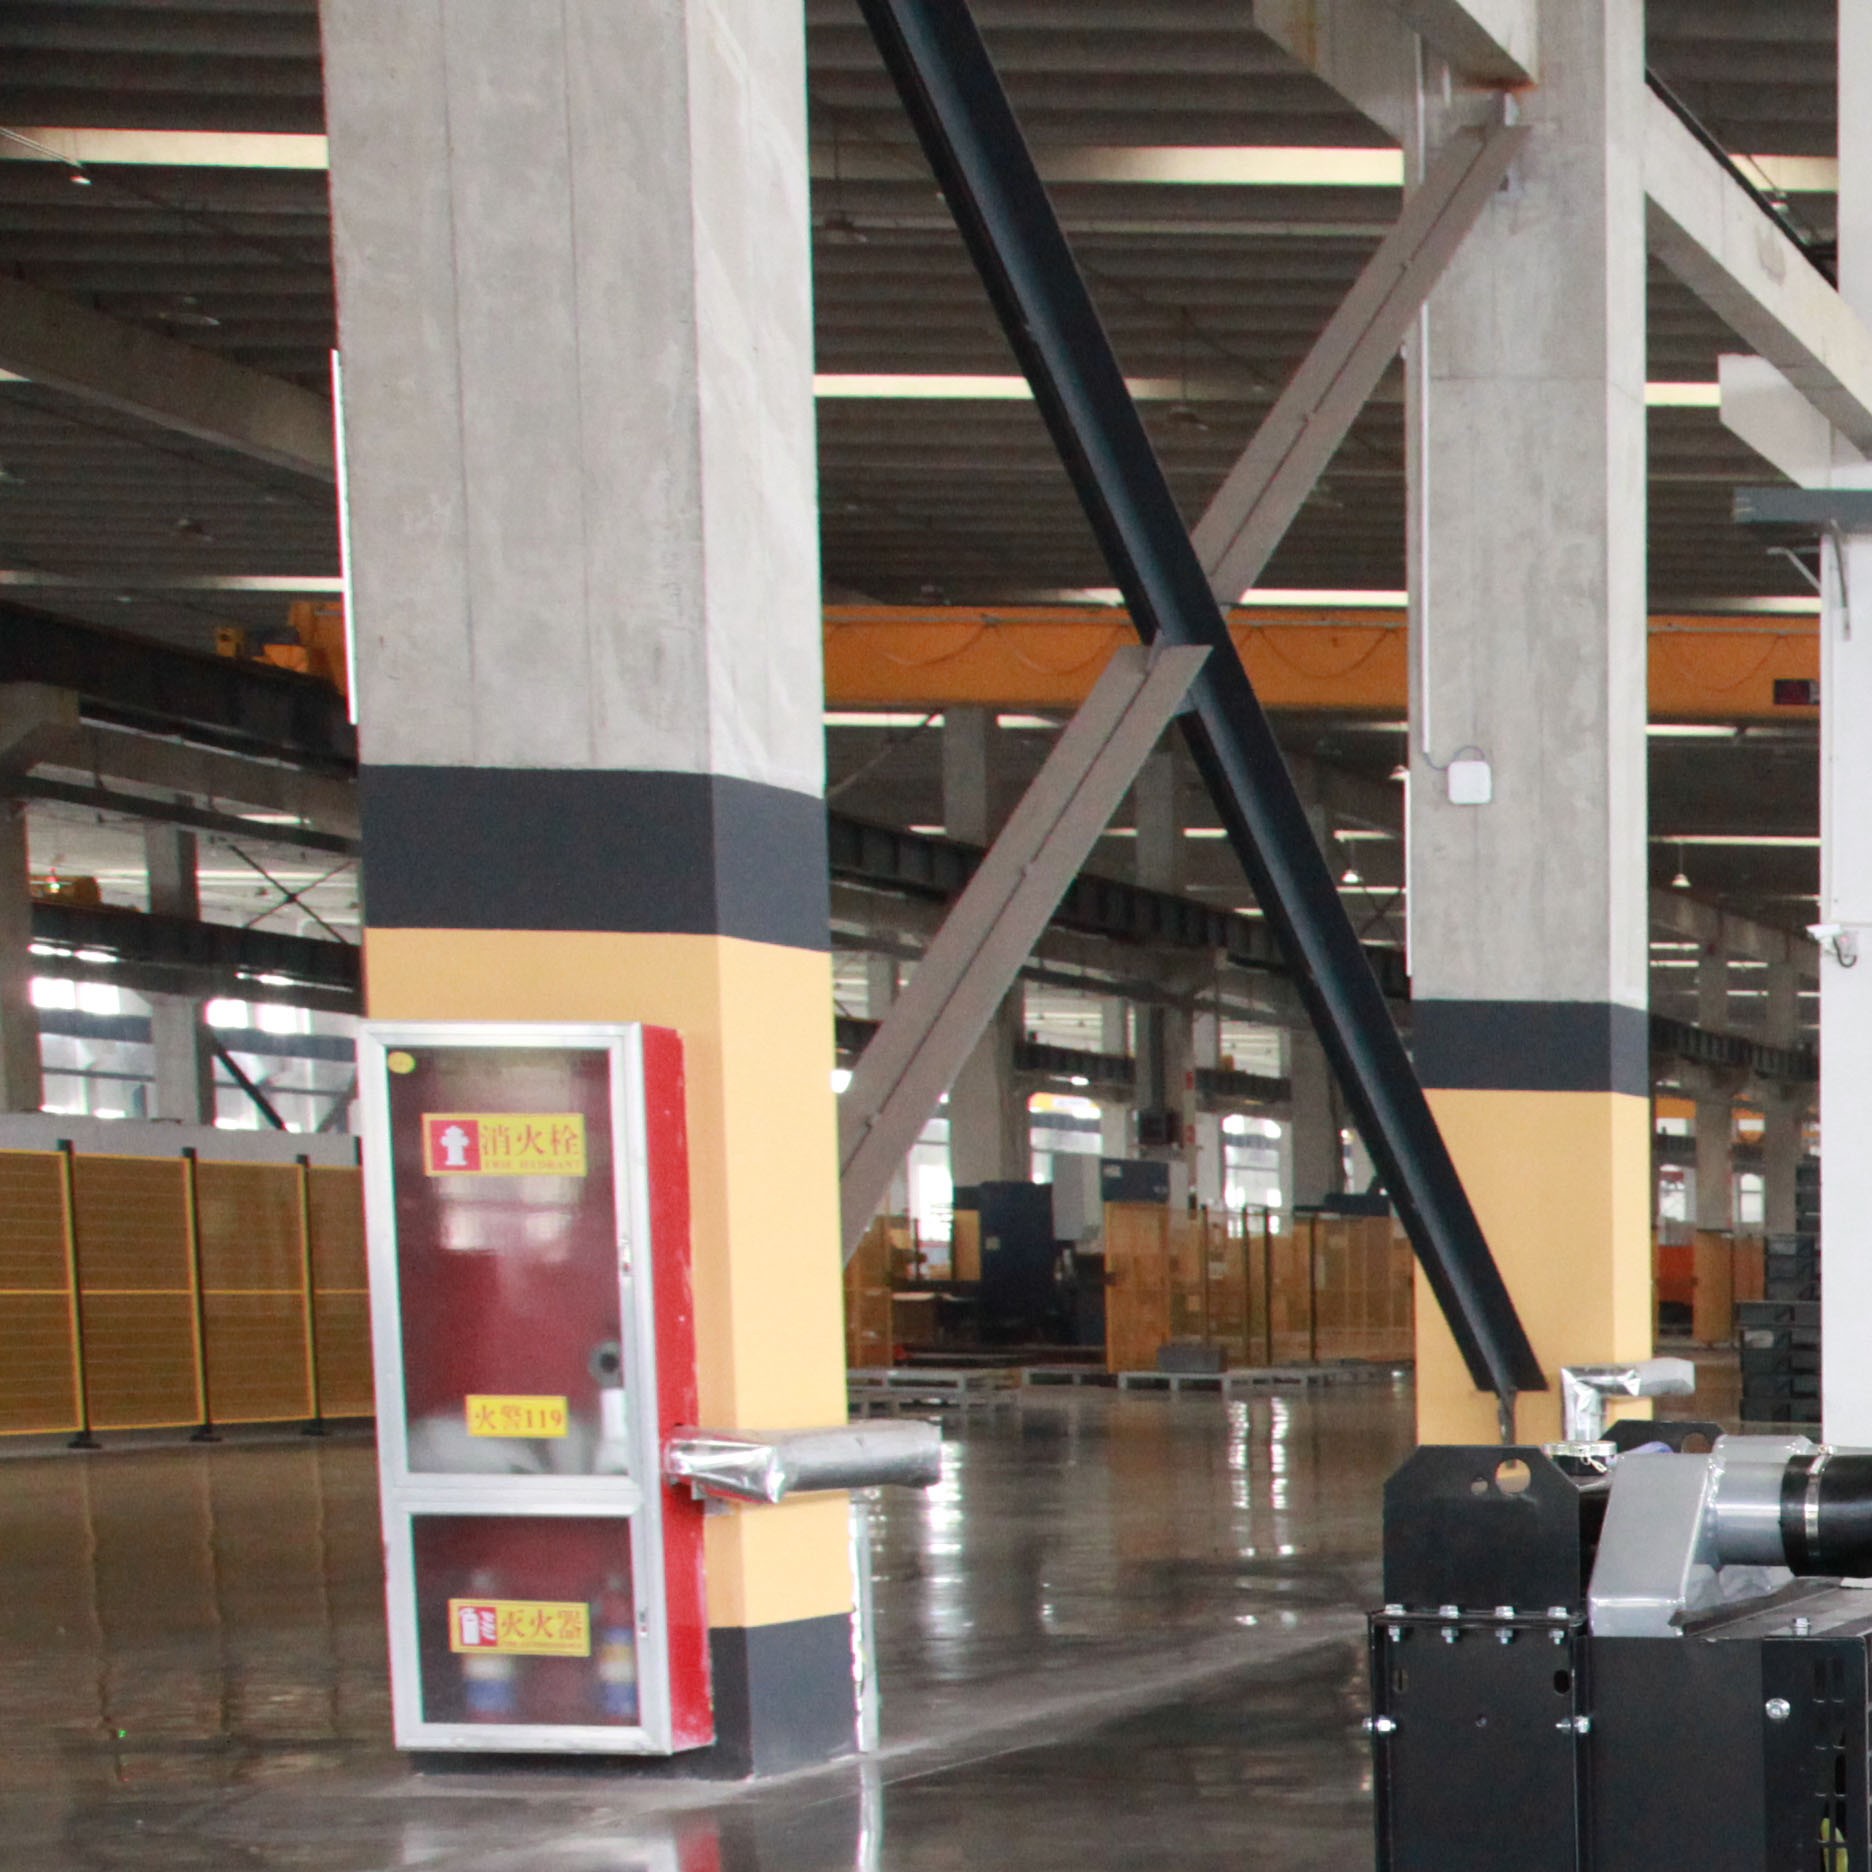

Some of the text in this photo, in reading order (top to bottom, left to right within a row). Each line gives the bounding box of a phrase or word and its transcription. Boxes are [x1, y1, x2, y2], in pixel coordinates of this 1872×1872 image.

[481, 1124, 580, 1156] 消火栓
[475, 1404, 563, 1430] 火警119
[501, 1608, 582, 1640] 灭火器
